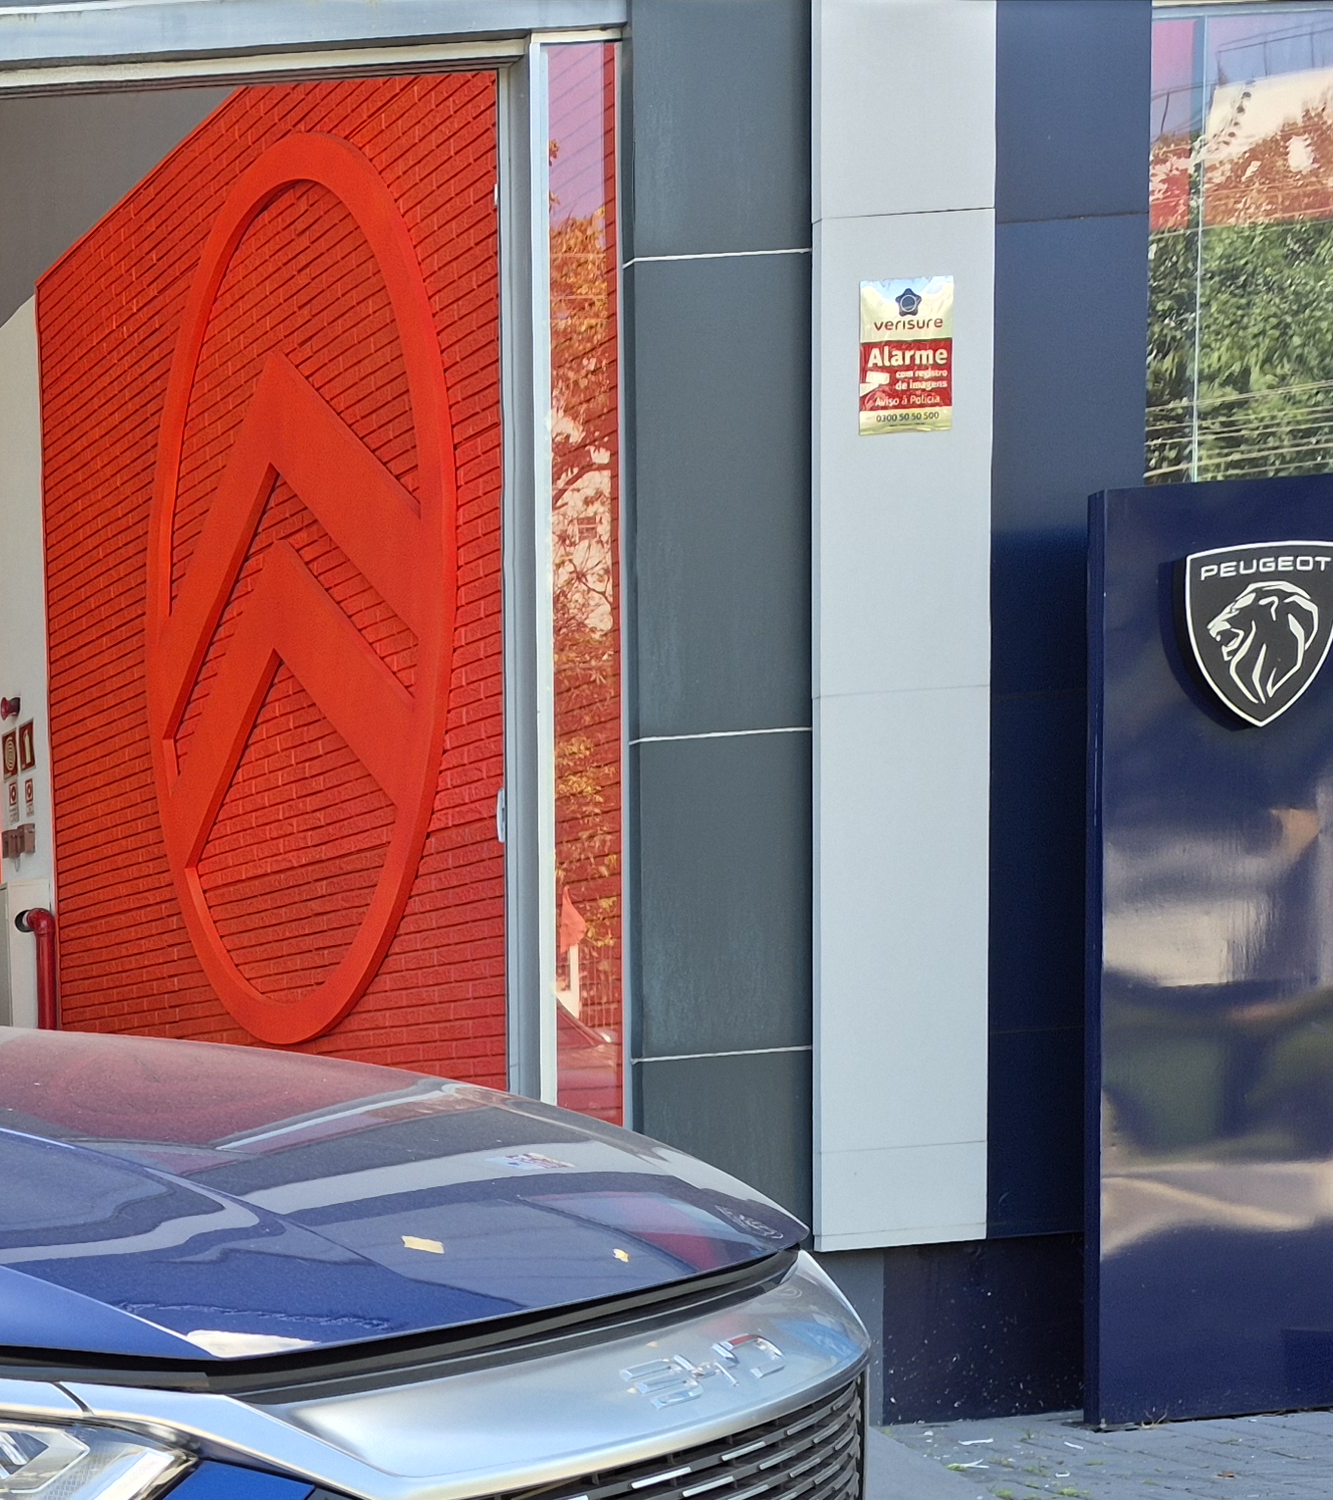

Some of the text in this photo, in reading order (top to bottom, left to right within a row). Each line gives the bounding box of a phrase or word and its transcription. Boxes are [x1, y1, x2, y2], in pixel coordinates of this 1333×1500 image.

[874, 318, 944, 331] verisure
[867, 346, 948, 368] Alarme
[895, 380, 908, 390] de
[875, 396, 900, 407] Aviso
[899, 413, 910, 421] 50
[911, 412, 922, 421] 50
[923, 411, 940, 420] 500
[1200, 556, 1332, 581] PEUGEOT
